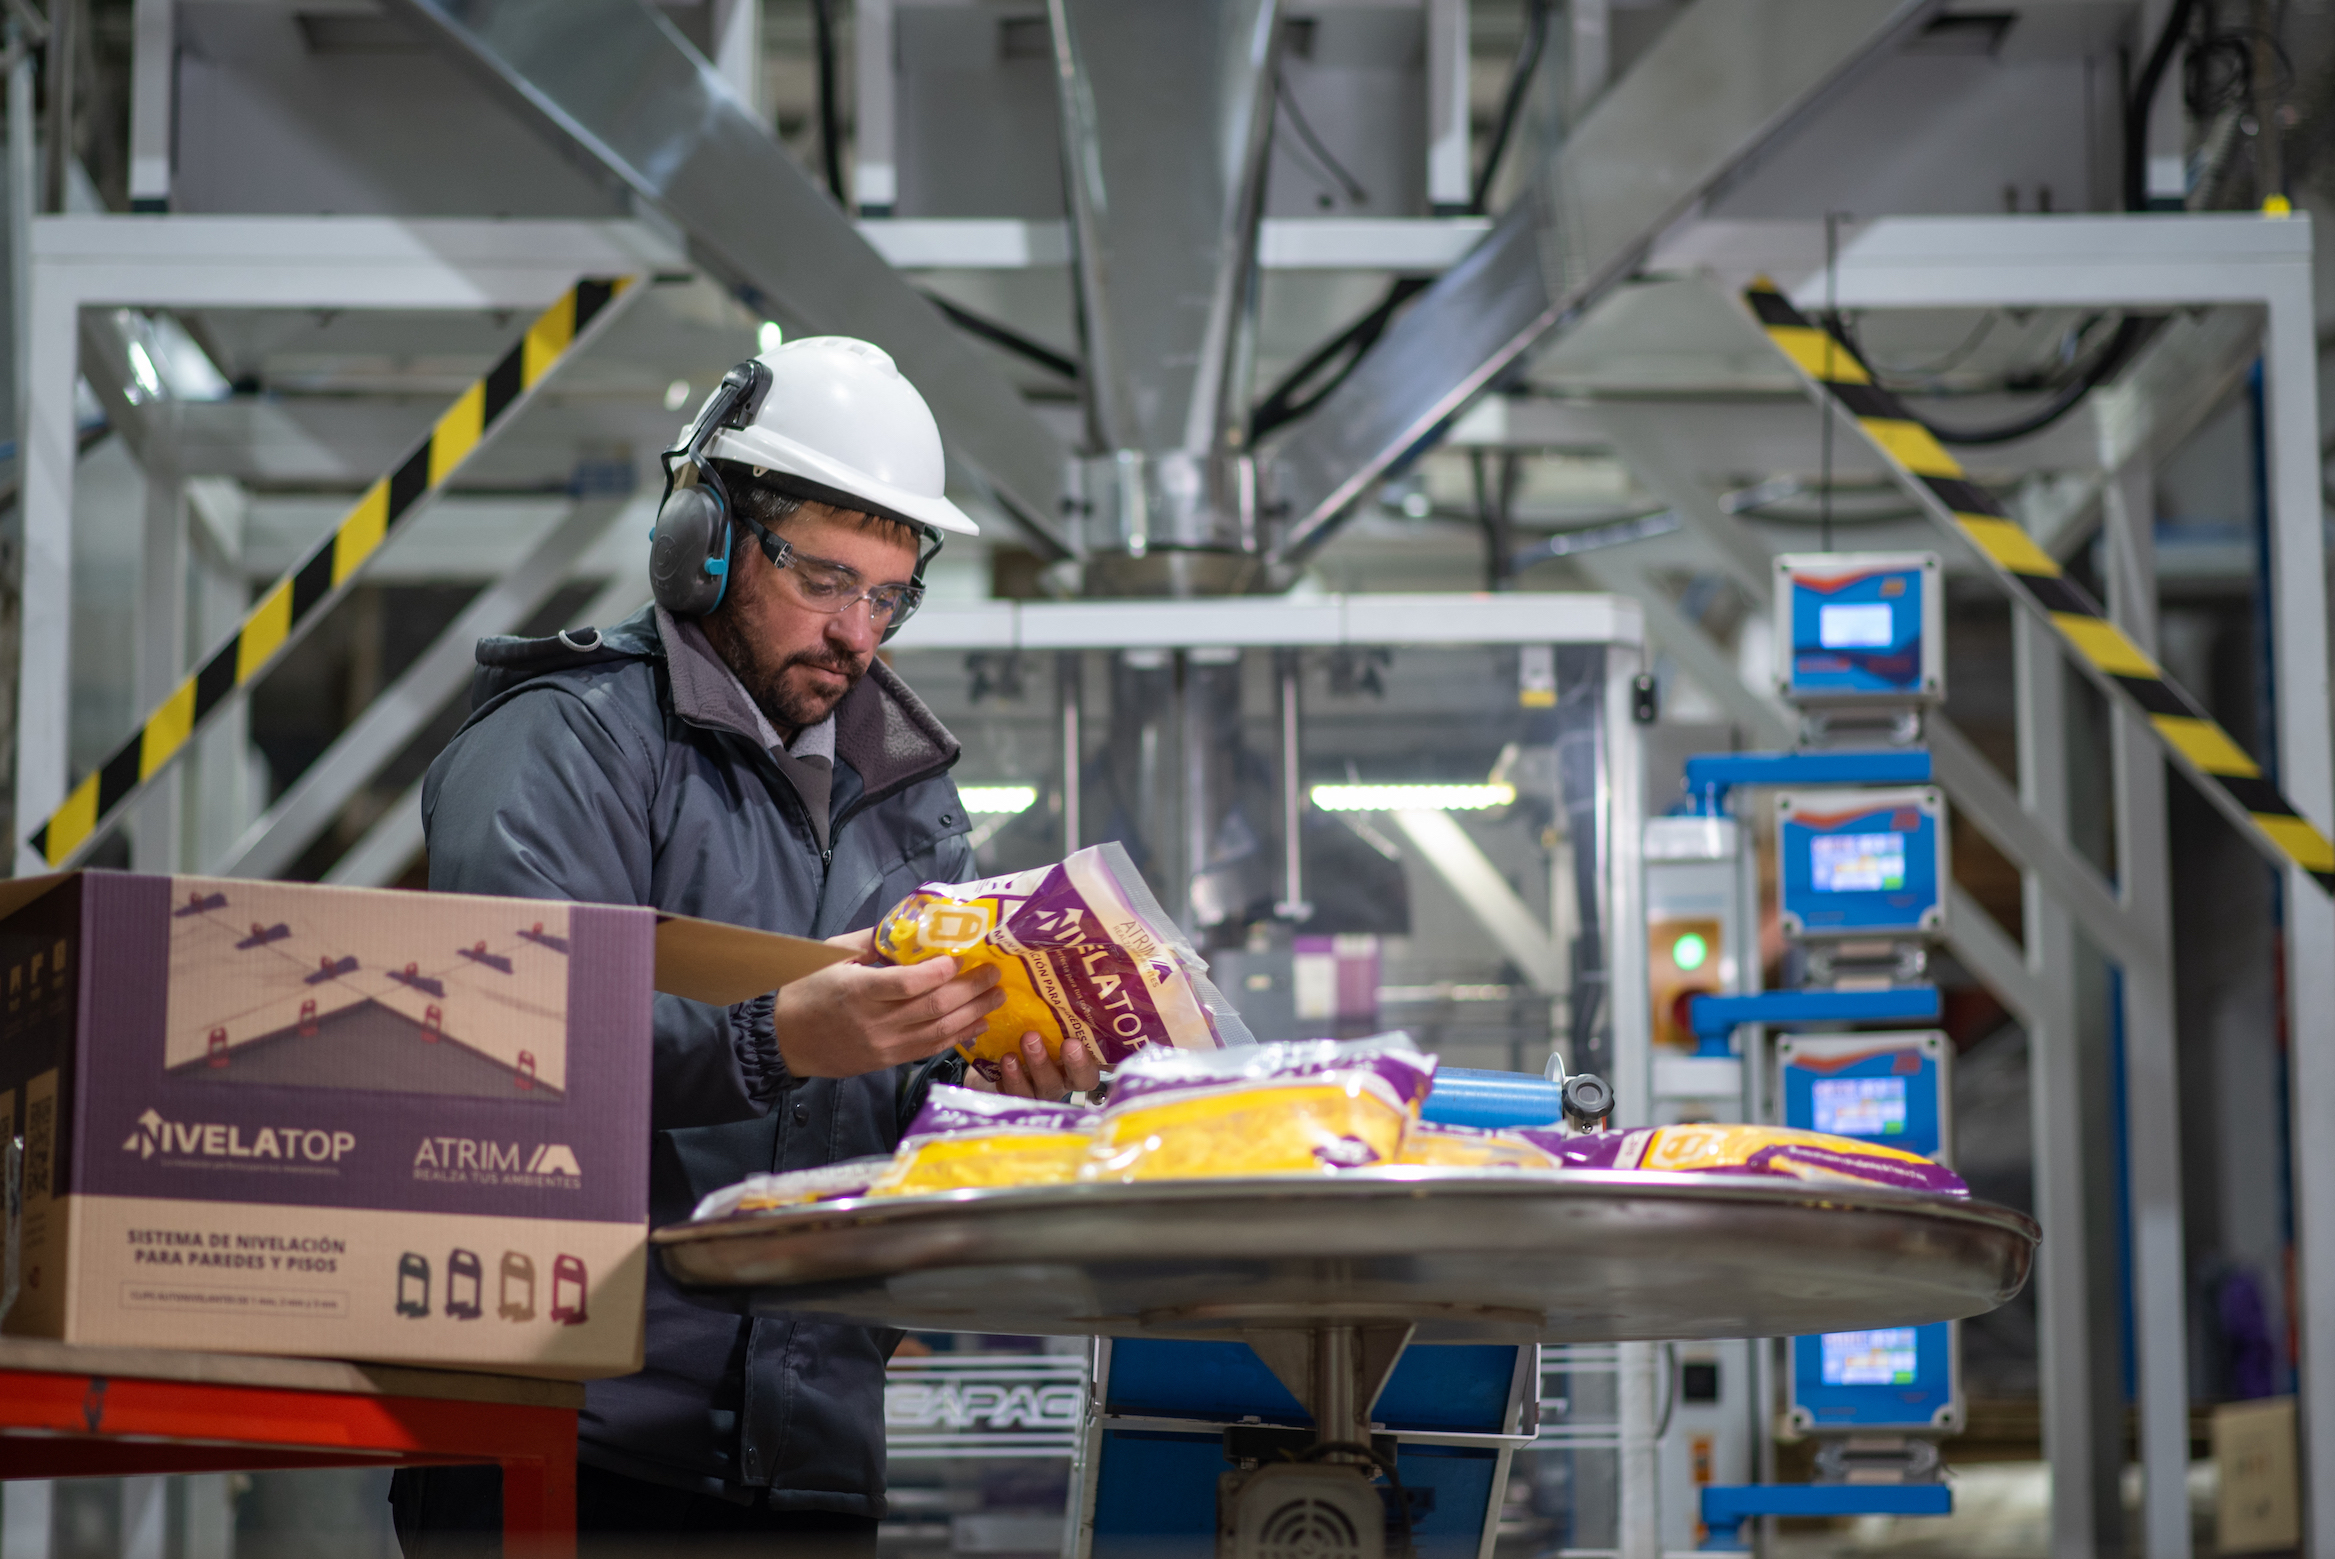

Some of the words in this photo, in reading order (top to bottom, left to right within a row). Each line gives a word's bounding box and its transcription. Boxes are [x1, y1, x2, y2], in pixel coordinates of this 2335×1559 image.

[1043, 979, 1061, 1006] PARA
[122, 1107, 356, 1162] NIVELATOP
[413, 1136, 520, 1172] ATRIM
[413, 1168, 467, 1183] REALZA
[472, 1171, 499, 1185] TUS
[502, 1173, 582, 1190] AMBIENTES
[127, 1228, 204, 1247] SISTEMA
[208, 1233, 230, 1249] DE
[235, 1234, 346, 1254] NIVELACIÓN
[134, 1248, 183, 1265] PARA
[188, 1251, 265, 1269] PAREDES
[269, 1255, 281, 1270] Y
[286, 1256, 337, 1273] PISOS
